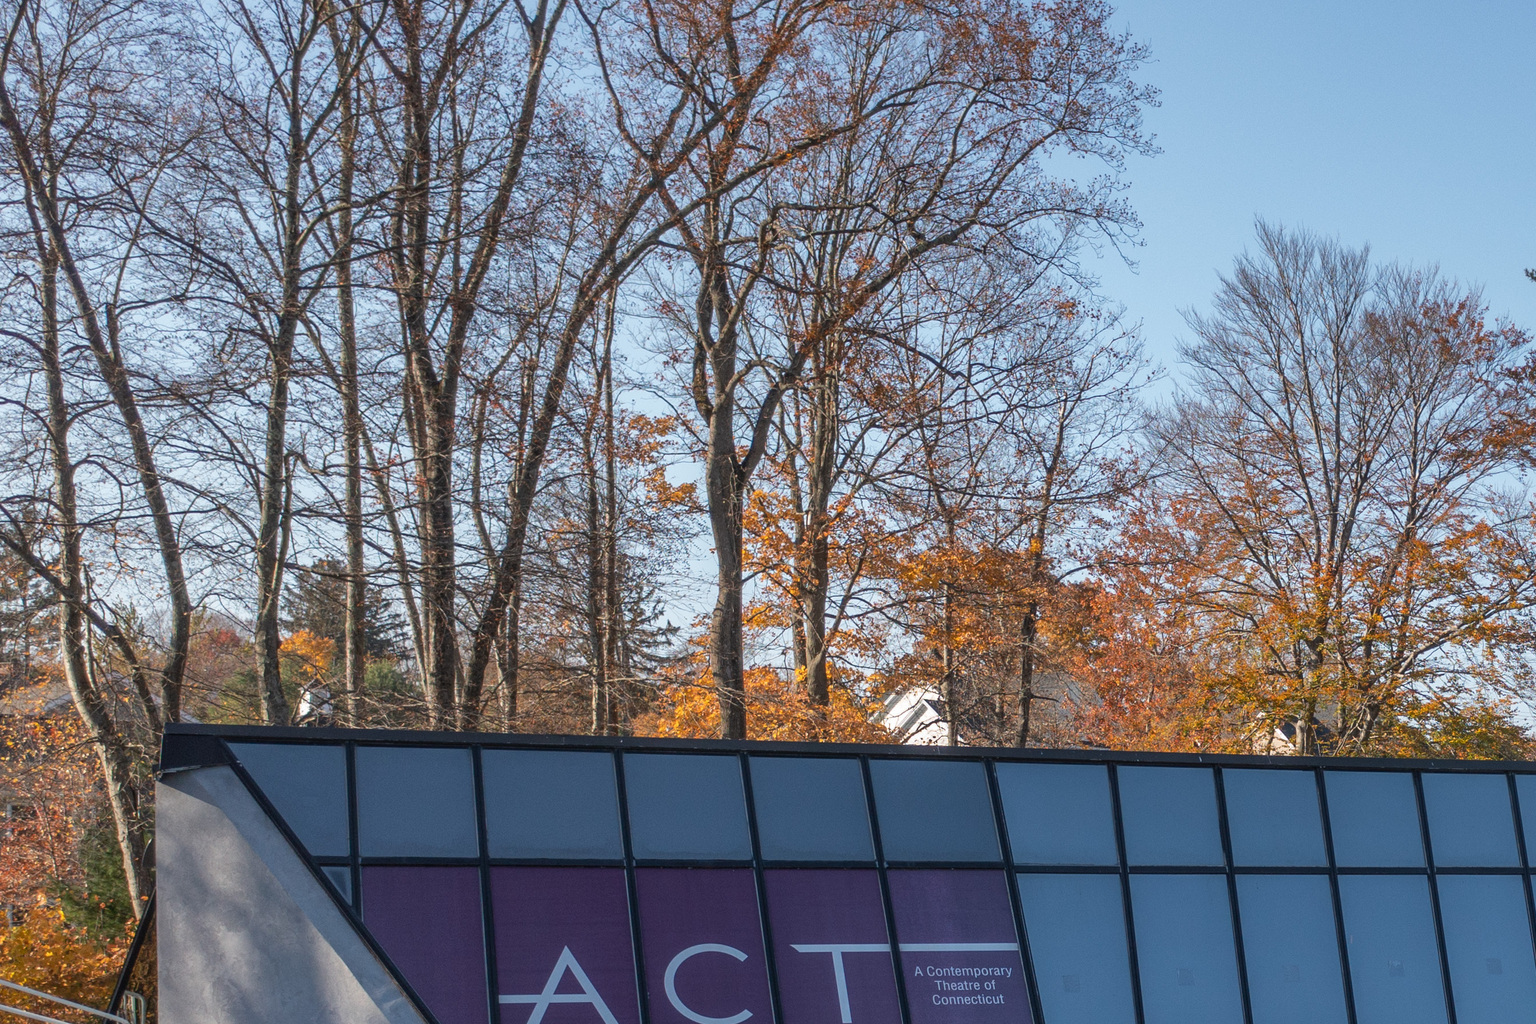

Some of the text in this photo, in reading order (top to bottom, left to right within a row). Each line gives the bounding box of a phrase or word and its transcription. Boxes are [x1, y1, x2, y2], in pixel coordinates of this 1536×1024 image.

[914, 965, 1013, 978] A Contemporary
[934, 979, 996, 991] Theatre of
[932, 993, 1005, 1005] Connecticut
